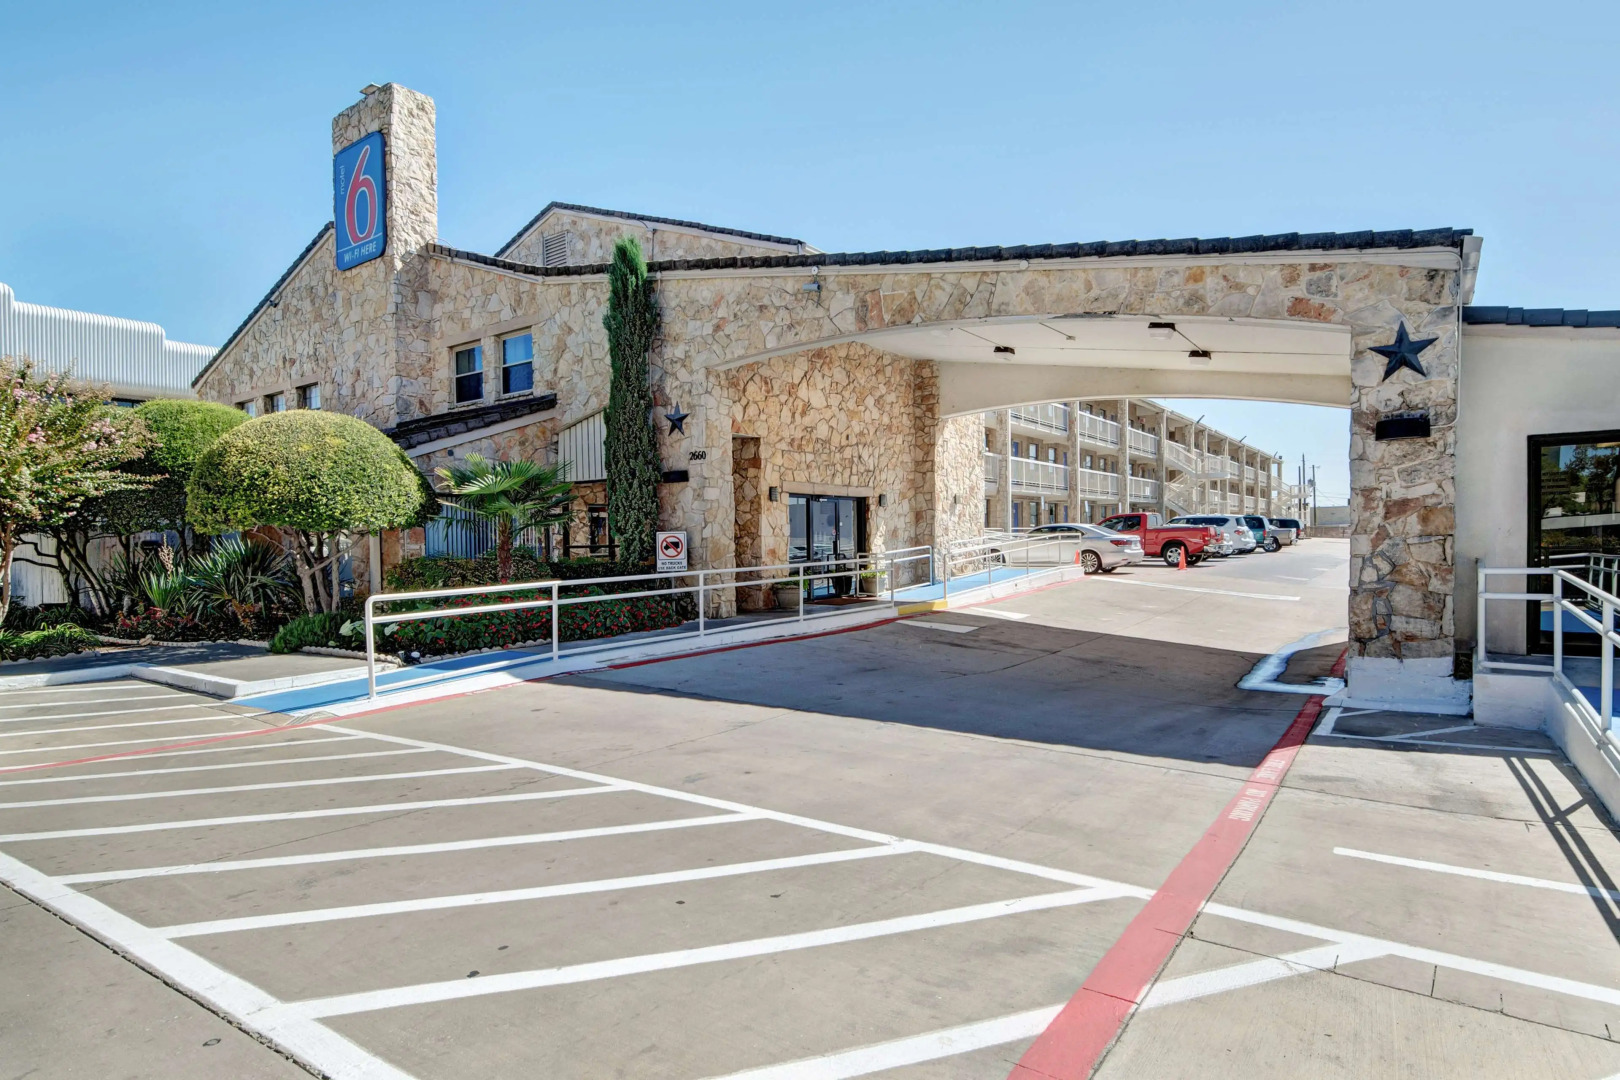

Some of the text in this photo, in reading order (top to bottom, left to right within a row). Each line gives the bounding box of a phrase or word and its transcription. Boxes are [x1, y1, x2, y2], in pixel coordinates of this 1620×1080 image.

[345, 144, 378, 246] 6
[344, 241, 377, 263] WI-FI HERE
[689, 450, 707, 461] 2660
[1245, 788, 1268, 797] NO
[1228, 797, 1262, 821] PARKING
